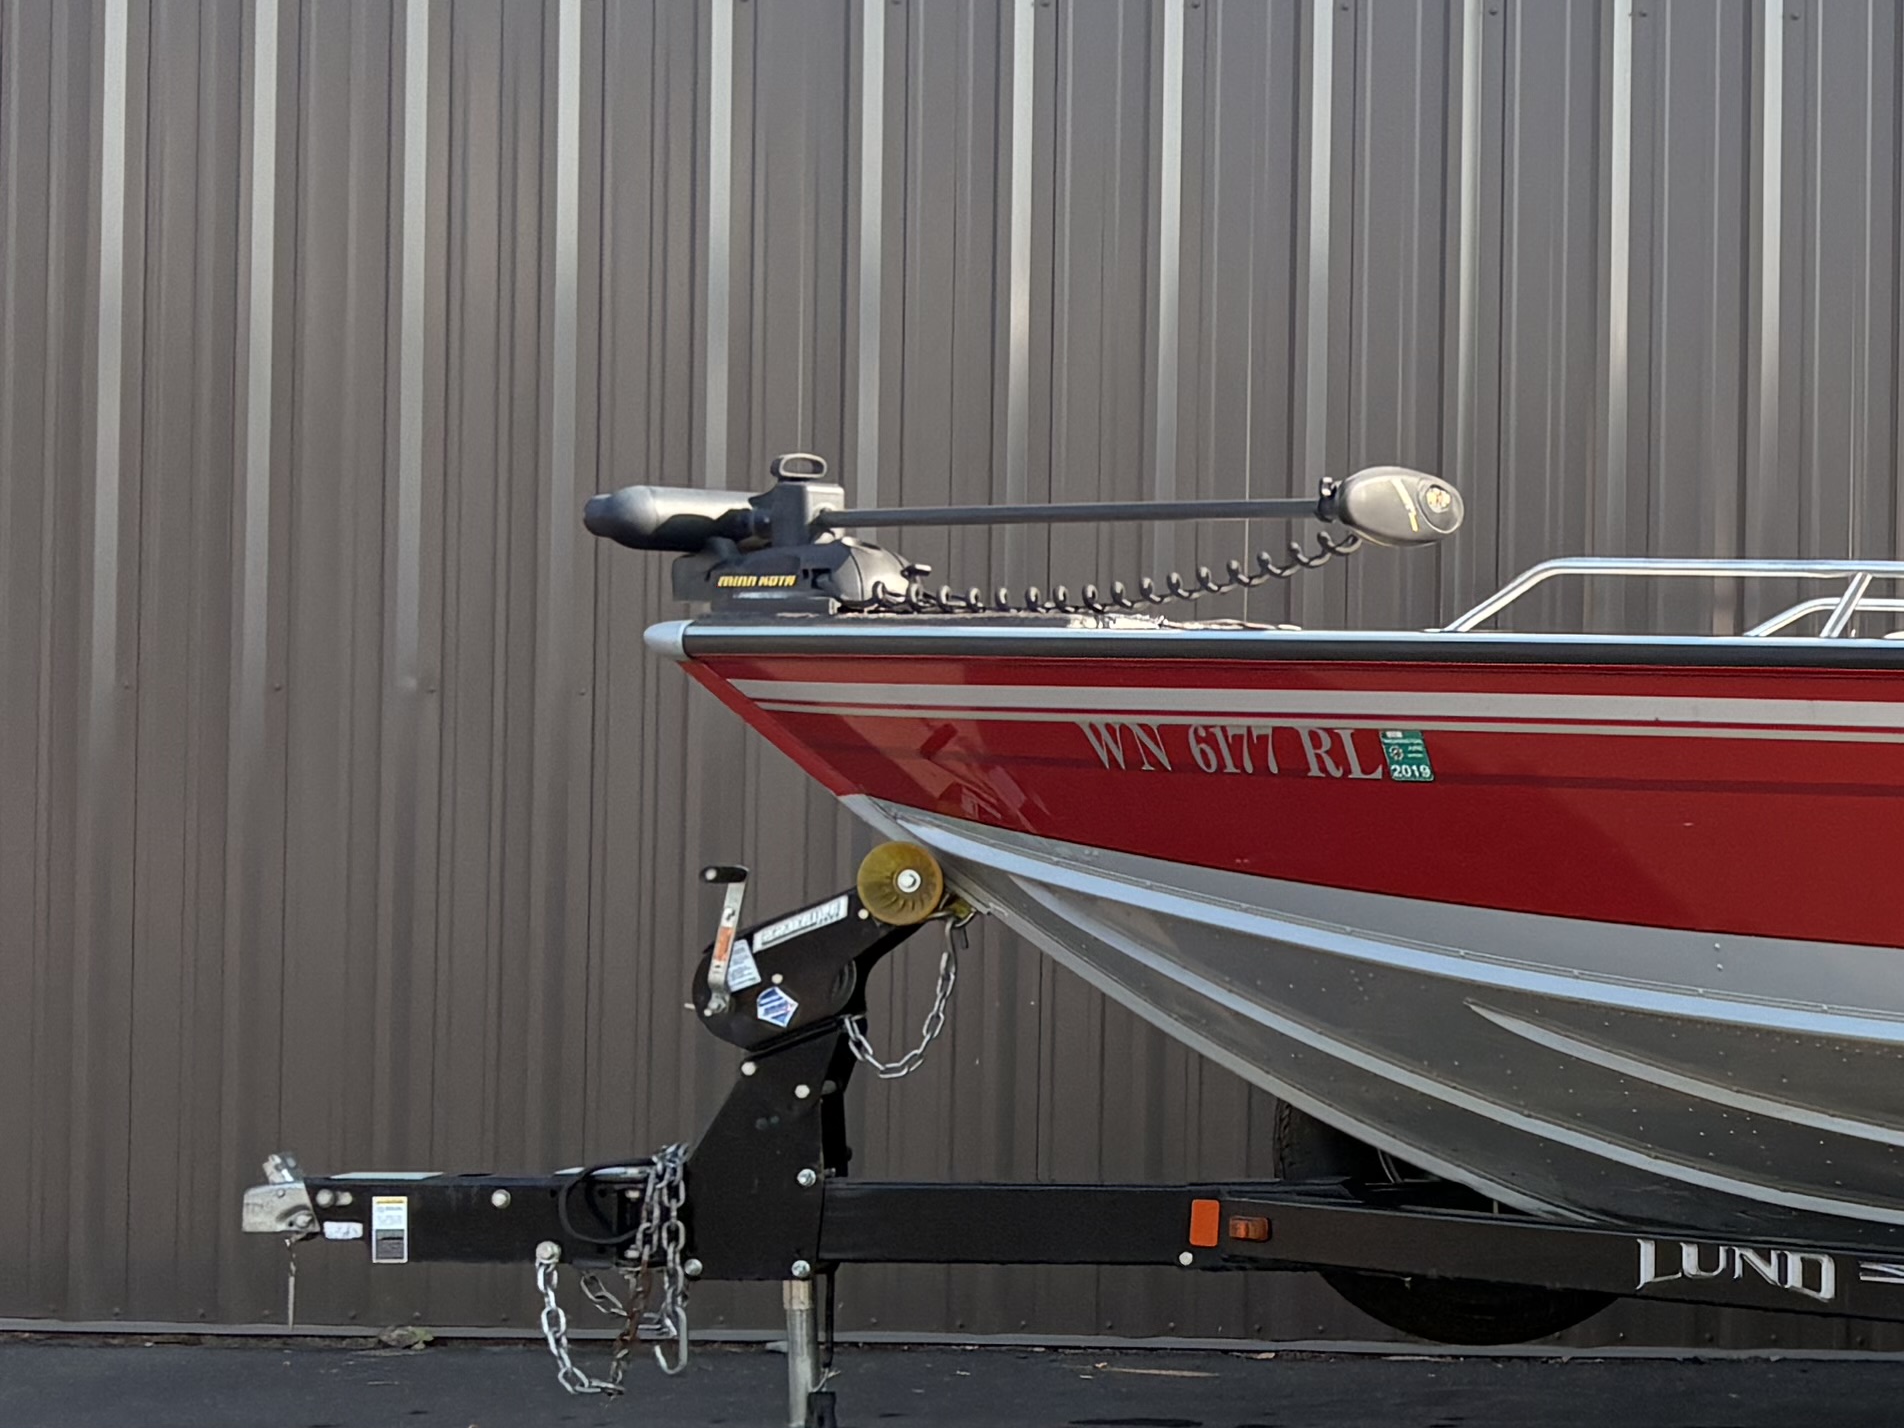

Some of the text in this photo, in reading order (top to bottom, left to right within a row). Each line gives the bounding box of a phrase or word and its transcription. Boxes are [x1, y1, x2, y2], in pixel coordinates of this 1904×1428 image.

[1078, 721, 1383, 780] WN 6177 RL
[1390, 764, 1431, 778] 2019
[1635, 1238, 1837, 1303] LUND
